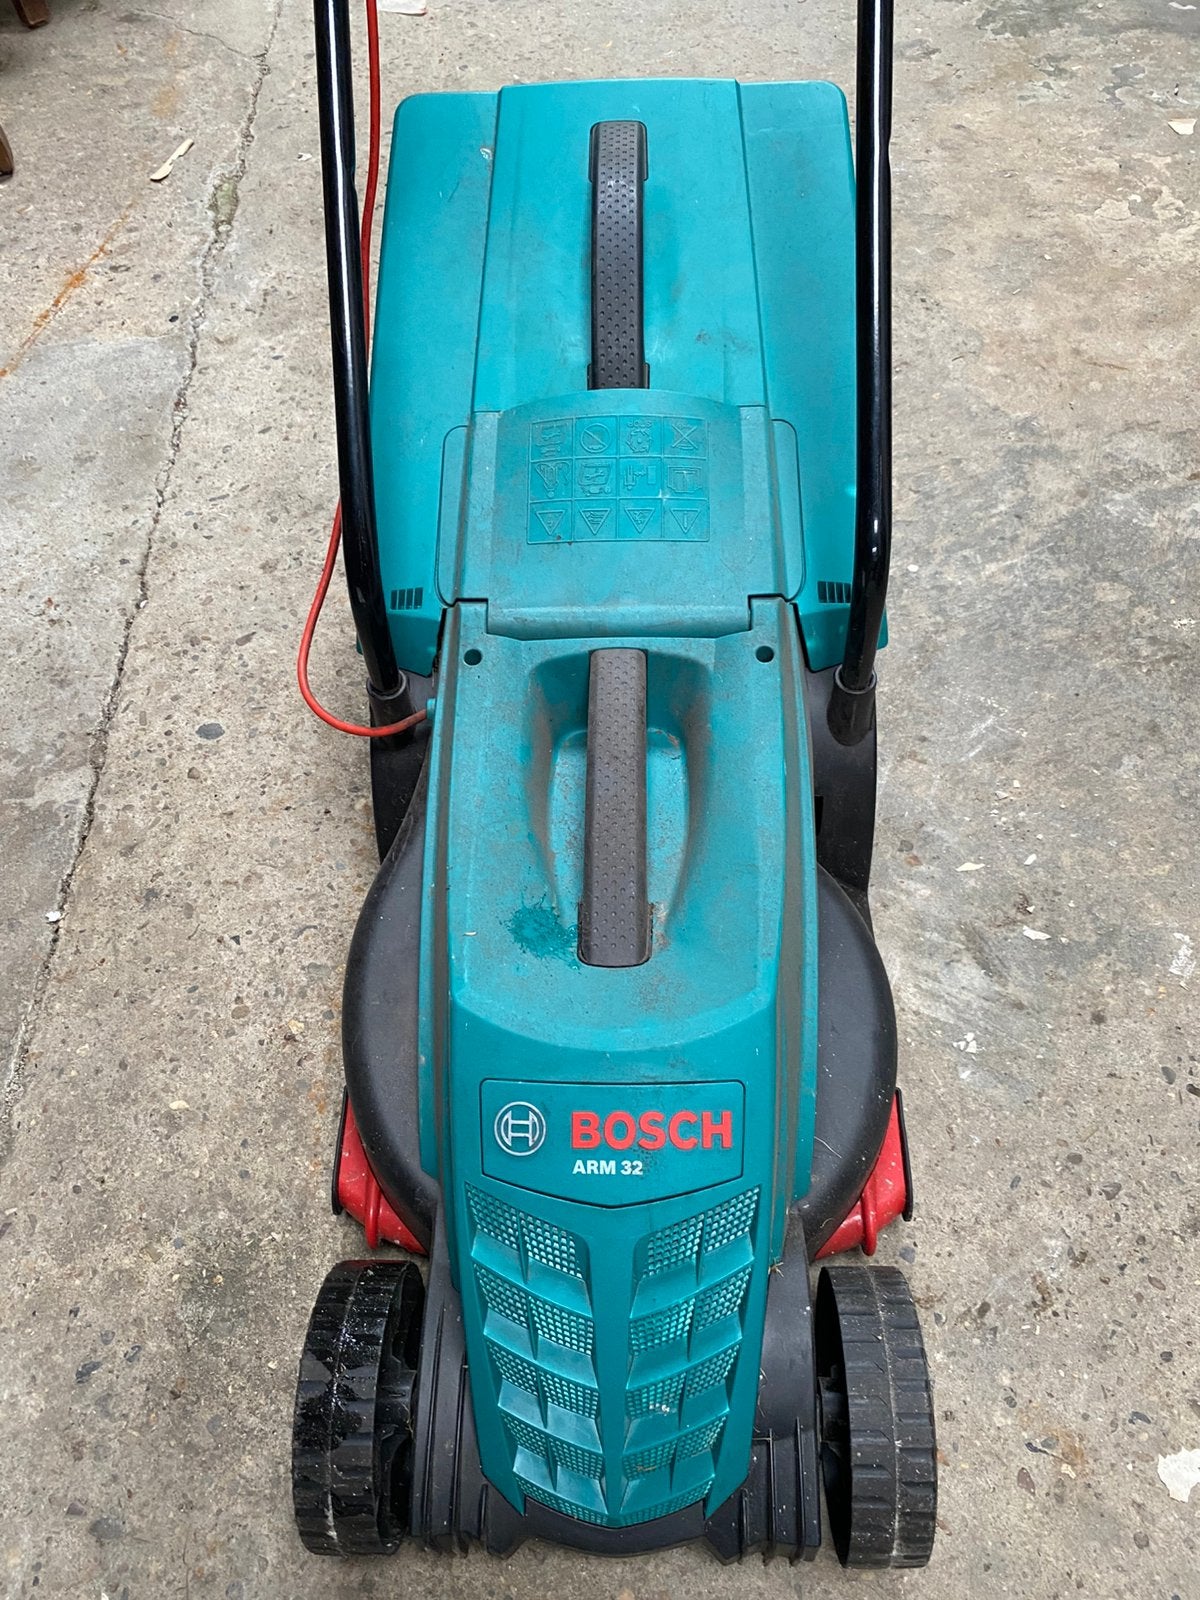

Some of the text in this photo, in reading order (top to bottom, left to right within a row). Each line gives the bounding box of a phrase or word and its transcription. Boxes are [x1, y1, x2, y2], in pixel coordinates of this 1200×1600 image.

[571, 1111, 732, 1150] BOSCH
[572, 1160, 643, 1175] ARM 32
